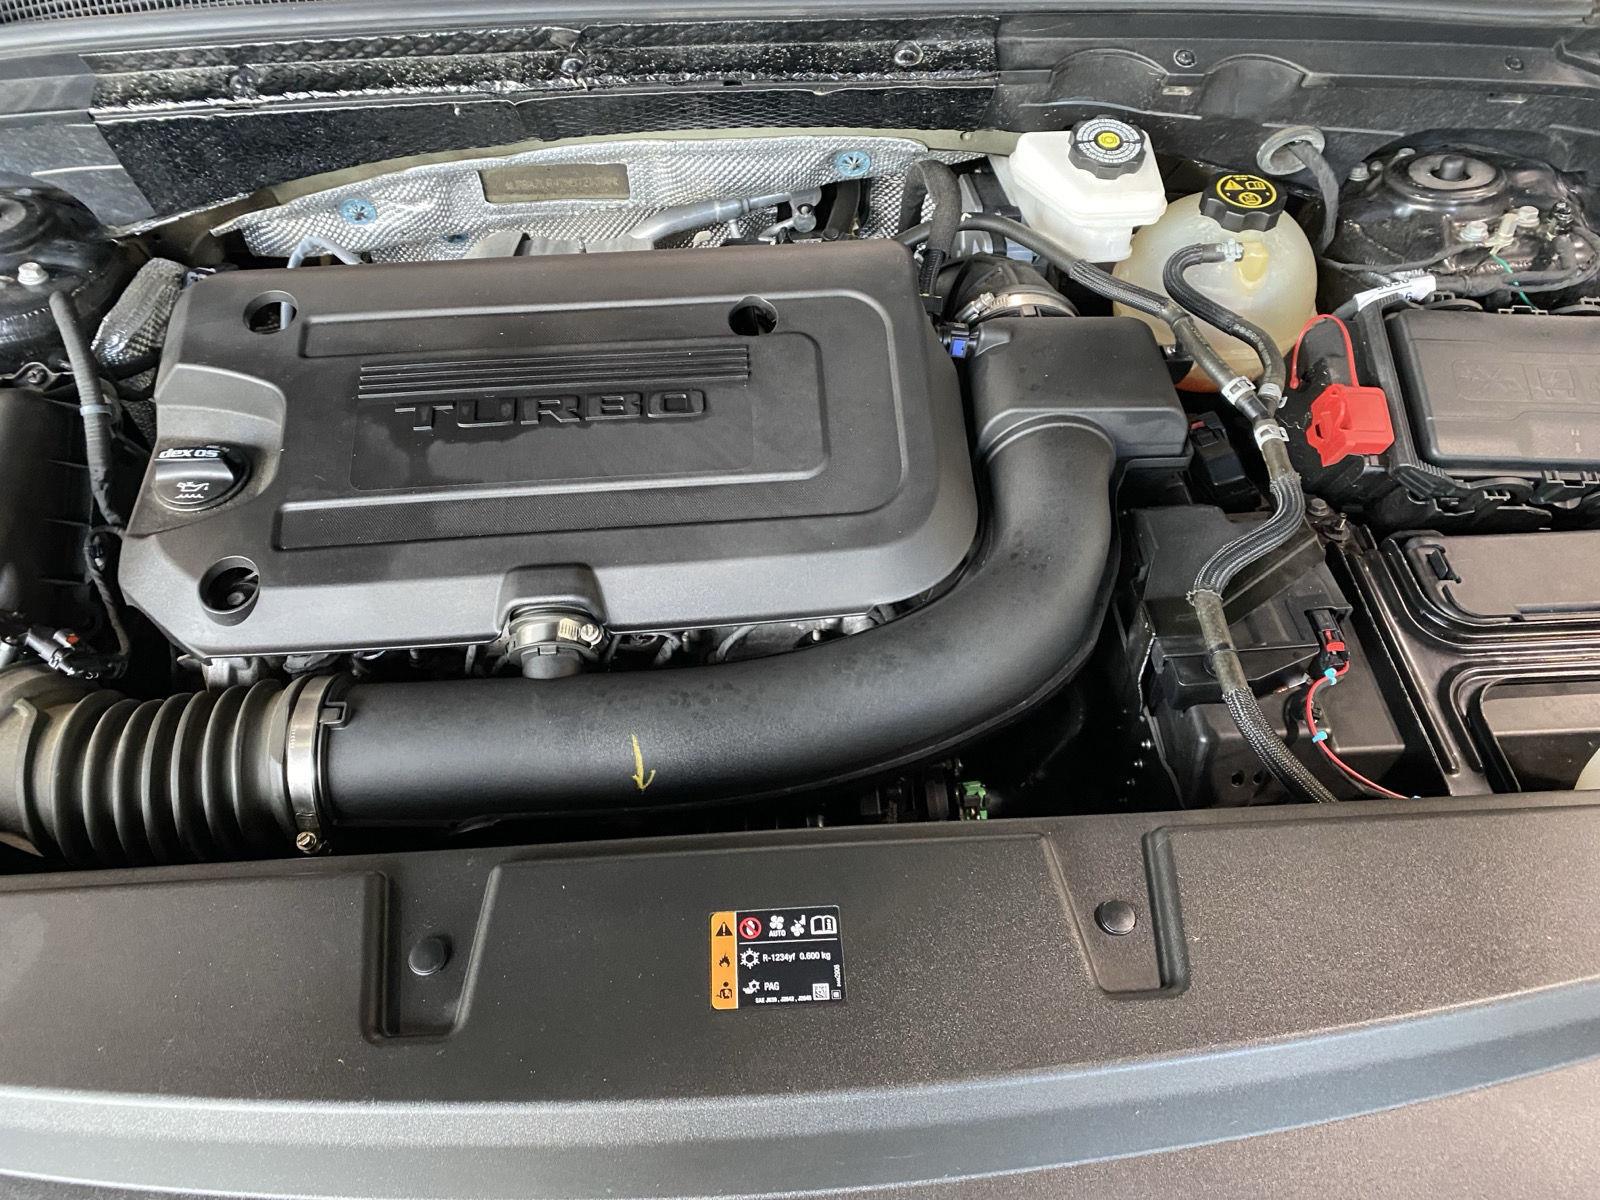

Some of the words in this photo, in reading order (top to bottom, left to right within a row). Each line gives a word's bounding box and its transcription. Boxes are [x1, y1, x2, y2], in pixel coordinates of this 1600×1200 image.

[394, 389, 706, 431] TURBO
[158, 448, 221, 458] dexos
[769, 929, 787, 937] AUTO
[762, 952, 796, 963] R-1234yf
[799, 951, 821, 961] 0.600
[821, 951, 831, 961] kg
[764, 981, 780, 991] PAG
